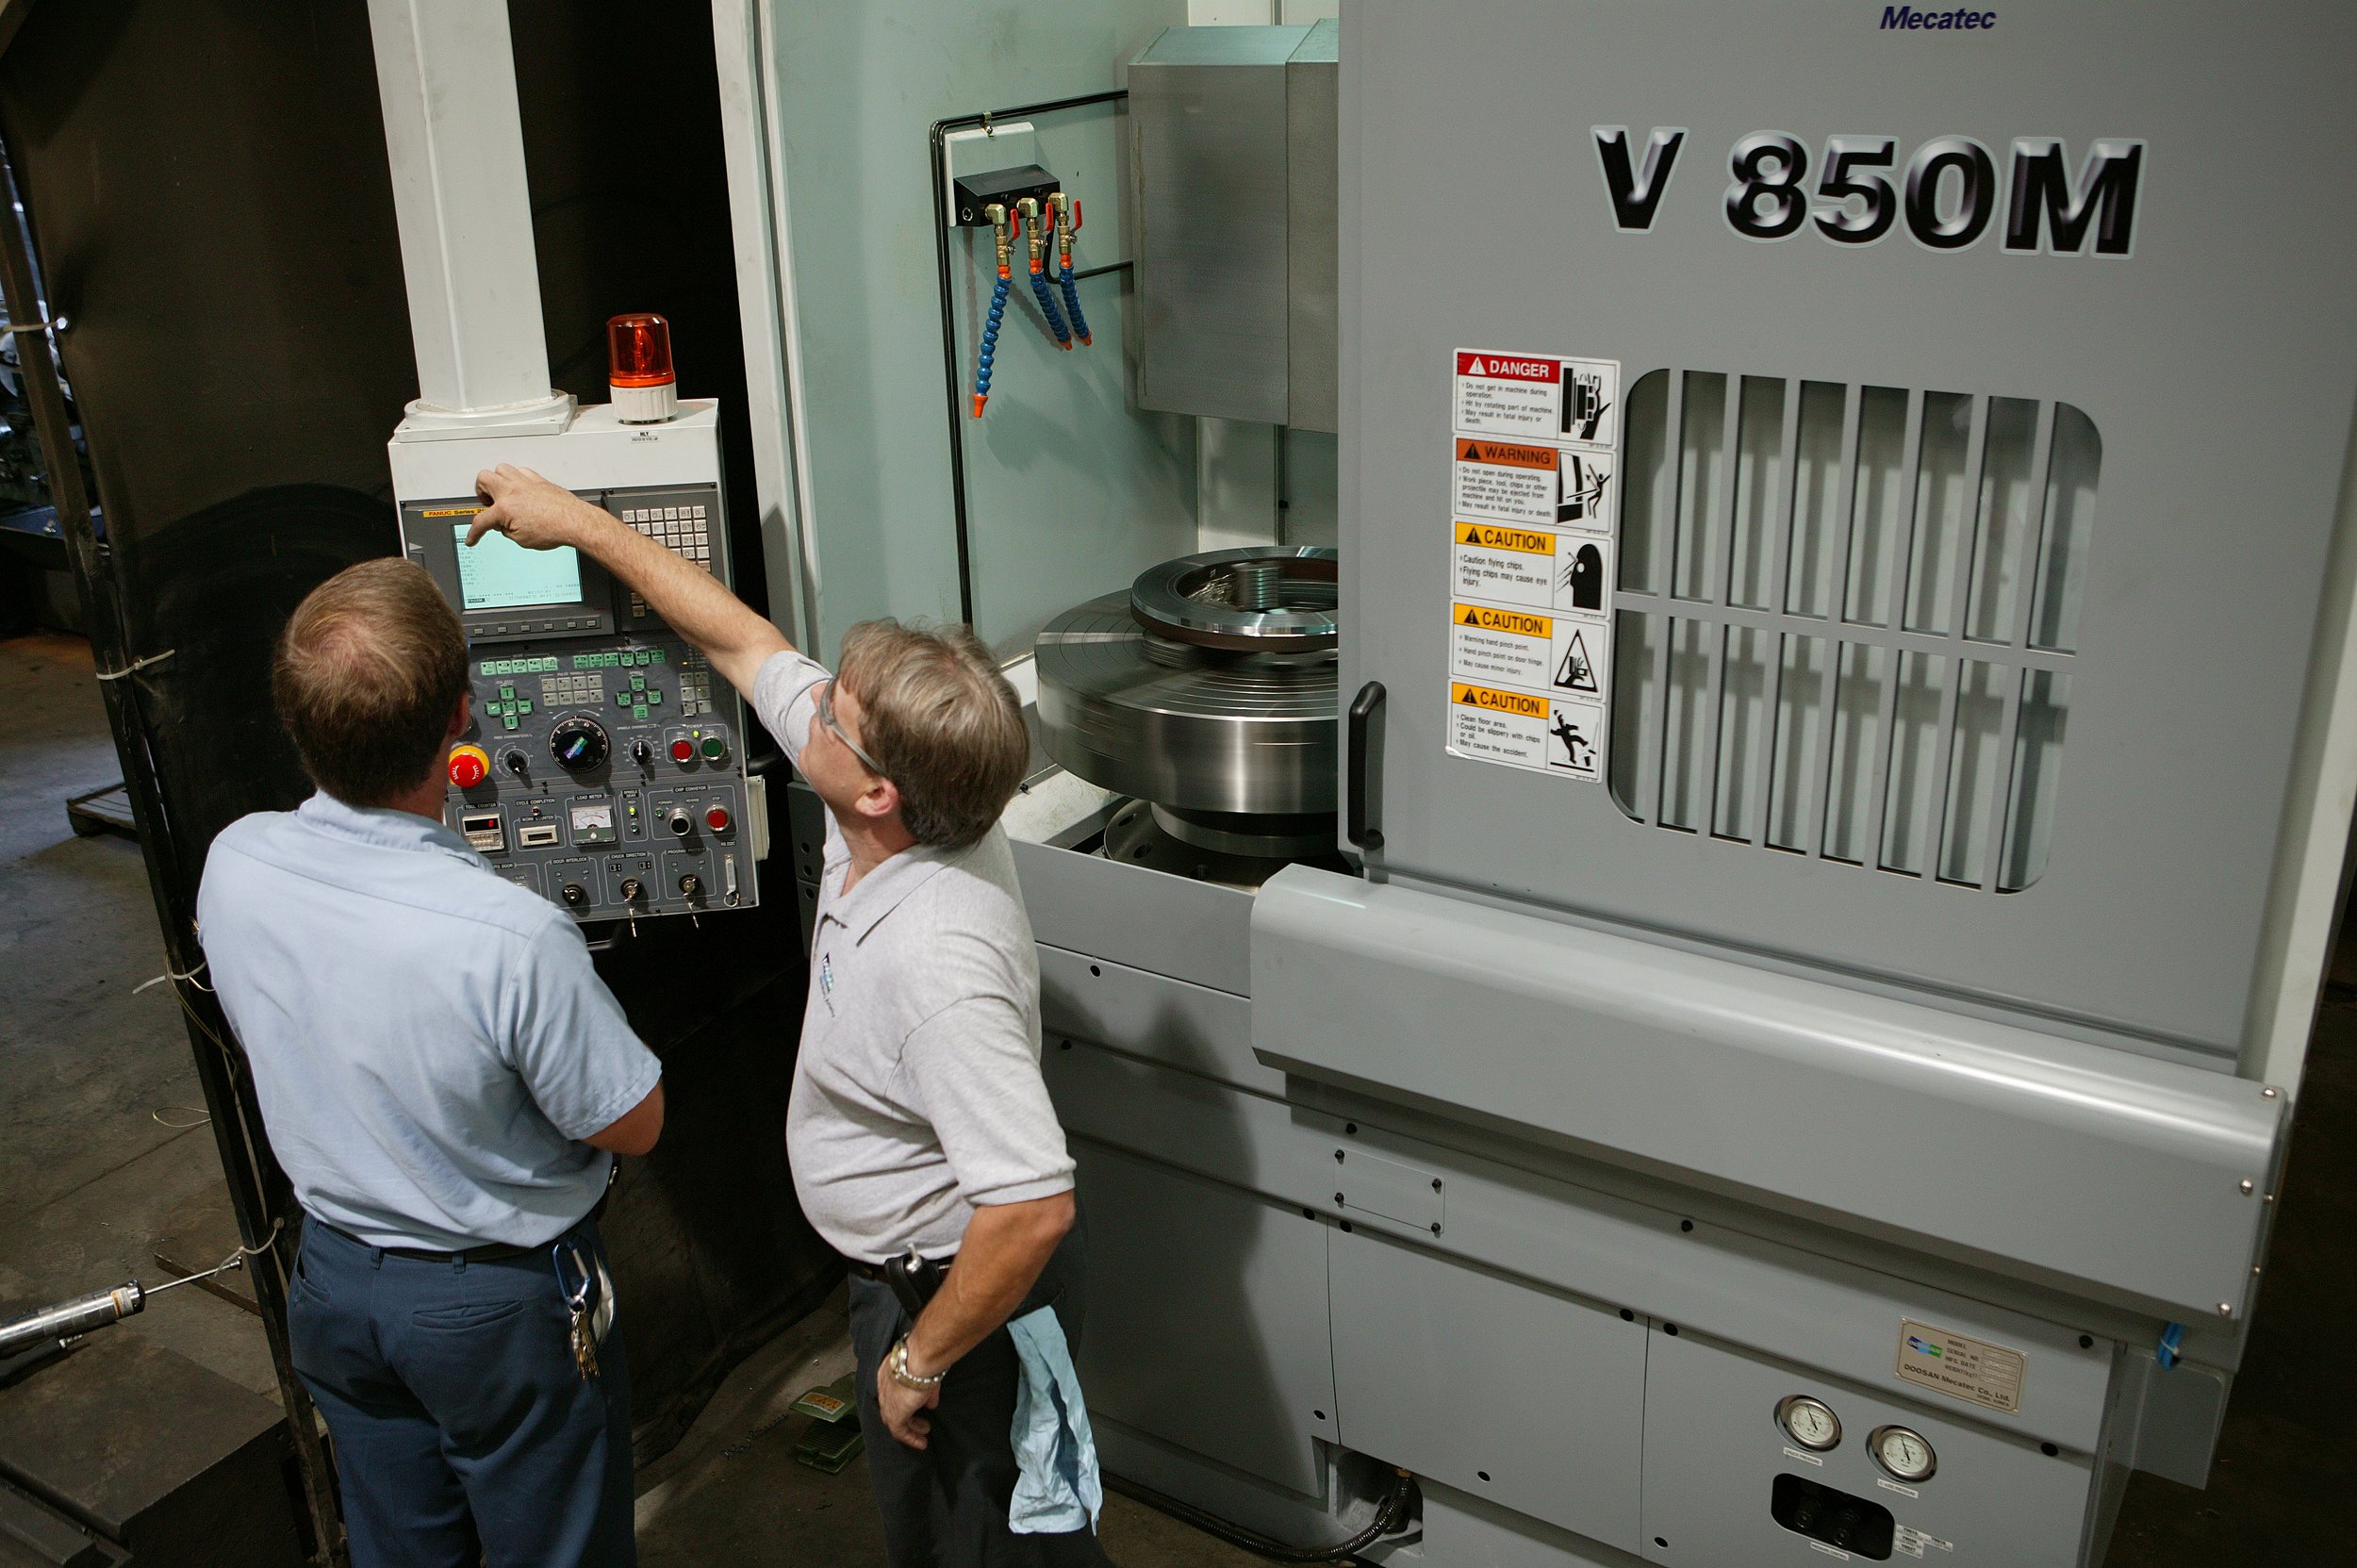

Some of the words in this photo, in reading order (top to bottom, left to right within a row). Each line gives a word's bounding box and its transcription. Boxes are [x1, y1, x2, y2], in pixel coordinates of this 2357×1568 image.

[1880, 6, 1997, 30] Mecatec
[1591, 125, 1689, 235] V
[1722, 130, 2148, 259] 850M
[1490, 360, 1549, 377] DANGER
[1518, 414, 1533, 422] injury
[1485, 446, 1550, 464] WARNING
[1510, 489, 1529, 498] ejected
[1485, 530, 1545, 551] CAUTION
[1463, 554, 1486, 564] Caution
[1489, 558, 1504, 569] flying
[1463, 567, 1480, 577] Flying
[1483, 569, 1498, 578] chips
[1501, 572, 1513, 581] may
[1516, 574, 1533, 583] cause
[1483, 612, 1542, 634] CAUTION
[1464, 635, 1484, 645] Warning
[1487, 637, 1498, 646] hand
[1480, 691, 1540, 714] CAUTION
[1460, 722, 1476, 732] Could
[1488, 729, 1508, 738] slippery
[1460, 739, 1471, 748] May
[1948, 1339, 1967, 1350] MODEL
[1946, 1347, 1967, 1359] SERIAL
[1961, 1361, 1976, 1370] DATE
[1904, 1363, 1939, 1380] DOOSAN
[1942, 1376, 1975, 1393] Mecatec
[1995, 1393, 2010, 1402] Ltd.
